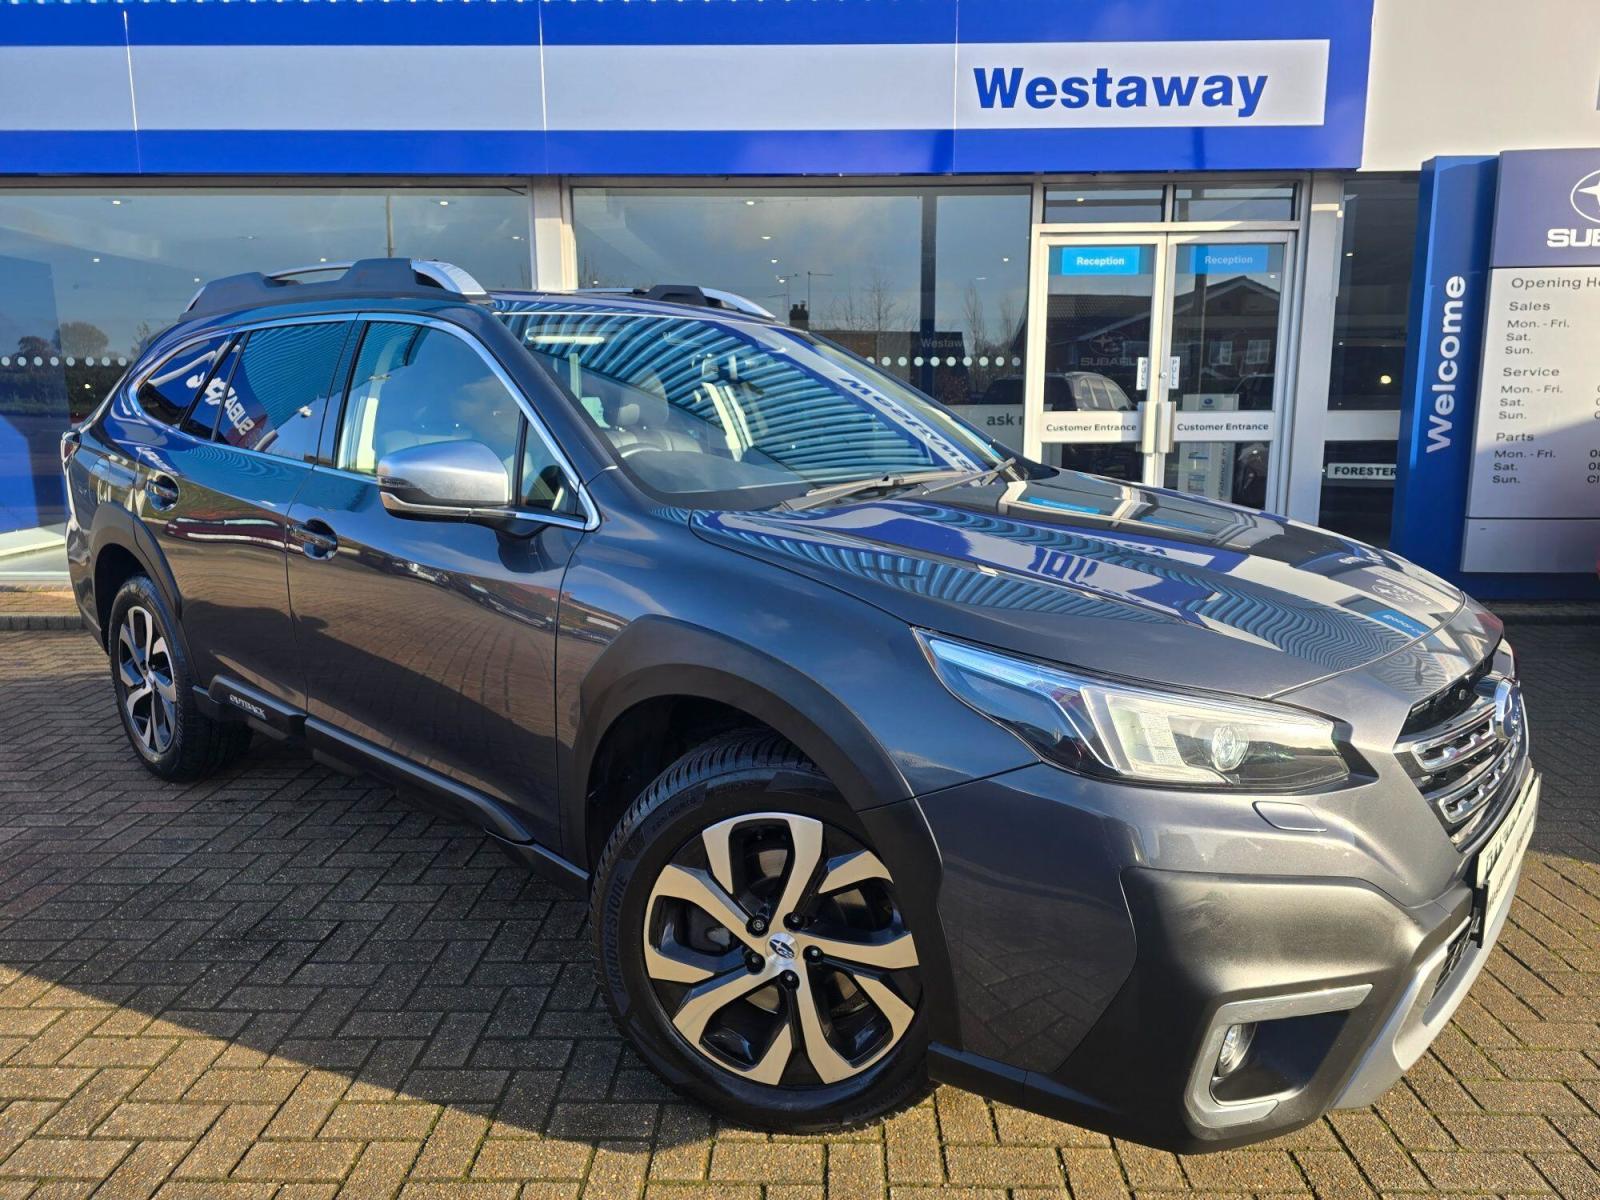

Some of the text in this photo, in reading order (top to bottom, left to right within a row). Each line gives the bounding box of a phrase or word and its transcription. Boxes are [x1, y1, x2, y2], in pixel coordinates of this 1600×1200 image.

[973, 68, 1268, 117] Westaway
[1076, 256, 1125, 267] Reception
[1204, 255, 1253, 266] Reception
[1511, 277, 1582, 290] Opening
[1508, 301, 1551, 311] Sales
[1506, 319, 1540, 328] Mon.
[1550, 319, 1570, 328] Fri.
[1505, 332, 1531, 341] Sat.
[1504, 345, 1533, 355] Sun.
[1426, 275, 1466, 453] Welcome
[1502, 366, 1560, 377] Service
[1500, 385, 1533, 394] Mon.
[1543, 384, 1564, 394] Fri.
[1499, 398, 1525, 407] Sat.
[986, 413, 1015, 426] ask
[1498, 411, 1527, 420] Sun.
[1046, 423, 1137, 432] Customer Entrance
[1177, 422, 1269, 432] Customer Entrance
[1495, 432, 1535, 442] Parts
[1494, 450, 1527, 459] Mon.
[1536, 449, 1557, 458] Fri.
[1493, 462, 1519, 471] Sat.
[1491, 475, 1520, 484] Sun.
